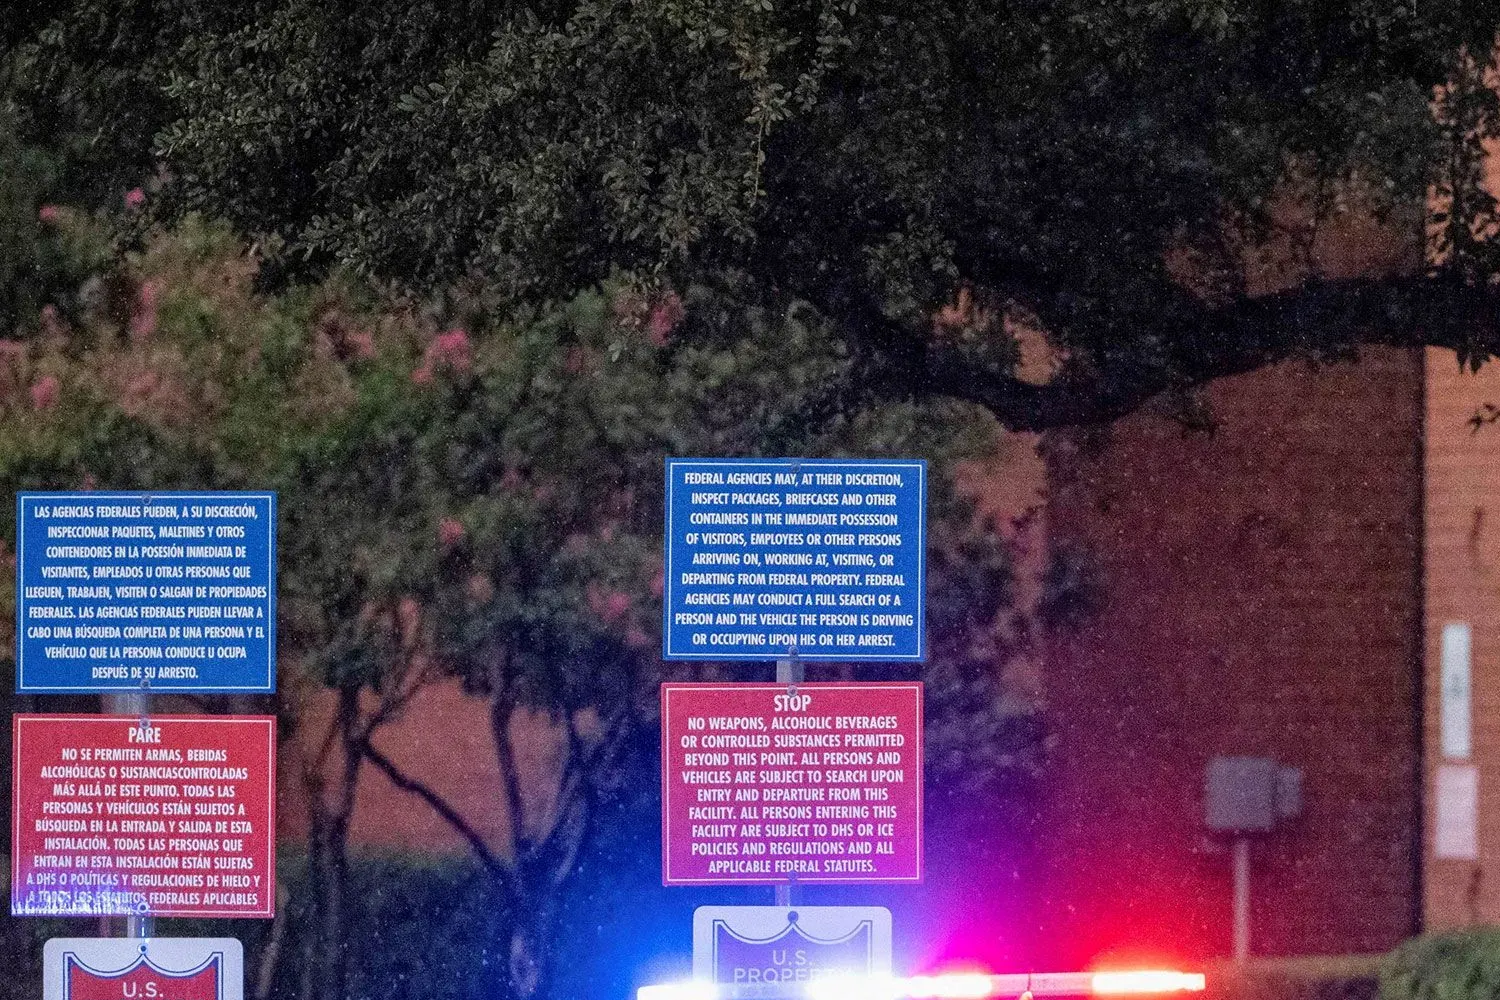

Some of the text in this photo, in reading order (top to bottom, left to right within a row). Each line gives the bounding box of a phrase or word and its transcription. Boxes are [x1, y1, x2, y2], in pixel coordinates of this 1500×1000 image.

[684, 473, 902, 487] FEDERAL AGENCIES MAY, AT THEIR DISCRETION,
[691, 493, 896, 506] INSPECT PACKAGES, BRIEFCASES AND OTHER
[34, 506, 50, 517] LAS
[52, 506, 94, 517] AGENCIAS
[96, 506, 141, 517] FEDERALES
[143, 506, 179, 519] PUEDEN,
[182, 506, 188, 517] A
[190, 506, 202, 517] SU
[689, 513, 897, 525] CONTAINERS IN THE IMMEDIATE POSSESSION
[47, 527, 244, 539] INSPECCIONAR PAQUETES, MALETINES Y OTROS
[685, 533, 901, 546] OF VISITORS, EMPLOYEES OR OTHER PERSONS
[45, 547, 112, 557] CONTENEDORES
[114, 547, 126, 557] EN
[128, 547, 139, 557] LA
[186, 547, 232, 557] INMEDIATA
[235, 547, 246, 557] DE
[692, 554, 894, 567] ARRIVING ON, WORKING AT, VISITING, OR
[681, 574, 904, 586] DEPARTING FROM FEDERAL PROPERTY. FEDERAL
[692, 634, 895, 646] OR OCCUPYING UPON HIS OR HER ARREST.
[130, 667, 142, 678] DE
[144, 667, 156, 678] SU
[158, 667, 198, 678] ARRESTO.
[774, 695, 810, 712] STOP
[687, 717, 897, 731] NO WEAPONS, ALCOHOLIC BEVERAGES
[680, 735, 904, 747] OR CONTROLLED SUBSTANCES PERMITTED
[61, 749, 227, 762] NO SE PERMITEN ARMAS, BEBIDAS
[684, 752, 900, 765] BEYOND THIS POINT. ALL PERSONS AND
[108, 767, 117, 778] O
[682, 771, 903, 783] VEHICLES ARE SUBJECT TO SEARCH UPON
[104, 785, 116, 796] DE
[119, 785, 140, 796] ESTE
[143, 785, 179, 796] PUNTO.
[183, 785, 214, 796] TODAS
[217, 785, 235, 796] LAS
[697, 788, 888, 801] ENTRY AND DEPARTURE FROM THIS
[688, 806, 896, 819] FACILITY. ALL PERSONS ENTERING THIS
[692, 824, 893, 837] FACILITY ARE SUBJECT TO DHS OR ICE
[691, 842, 893, 855] POLICIES AND REGULATIONS AND ALL
[708, 860, 876, 872] APPLICABLE FEDERAL STATUTES.
[123, 981, 164, 997] U.S.
